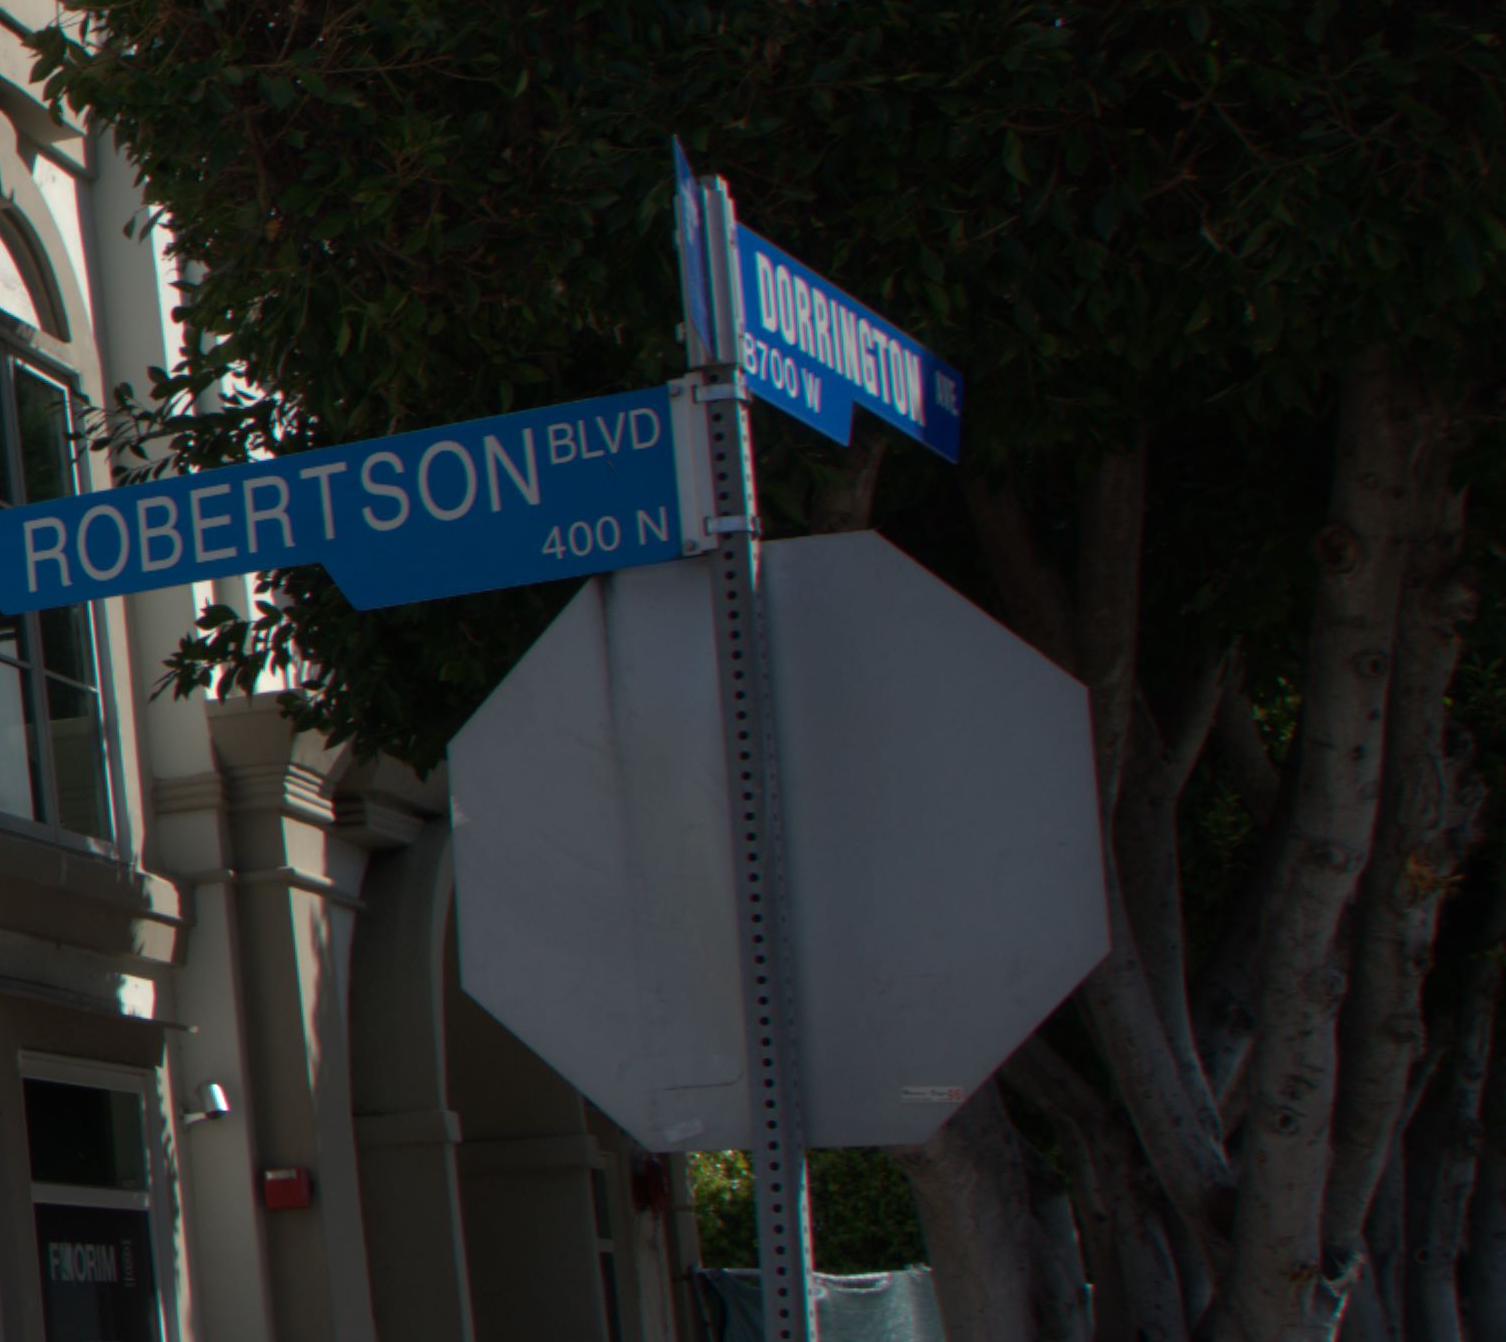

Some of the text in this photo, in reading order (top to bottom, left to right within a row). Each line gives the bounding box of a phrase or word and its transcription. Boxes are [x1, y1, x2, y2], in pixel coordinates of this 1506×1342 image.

[743, 332, 822, 415] 8700 W
[755, 251, 926, 427] DORRINGTON
[22, 406, 662, 593] ROBERTSON BLVD
[542, 505, 670, 561] 400 N
